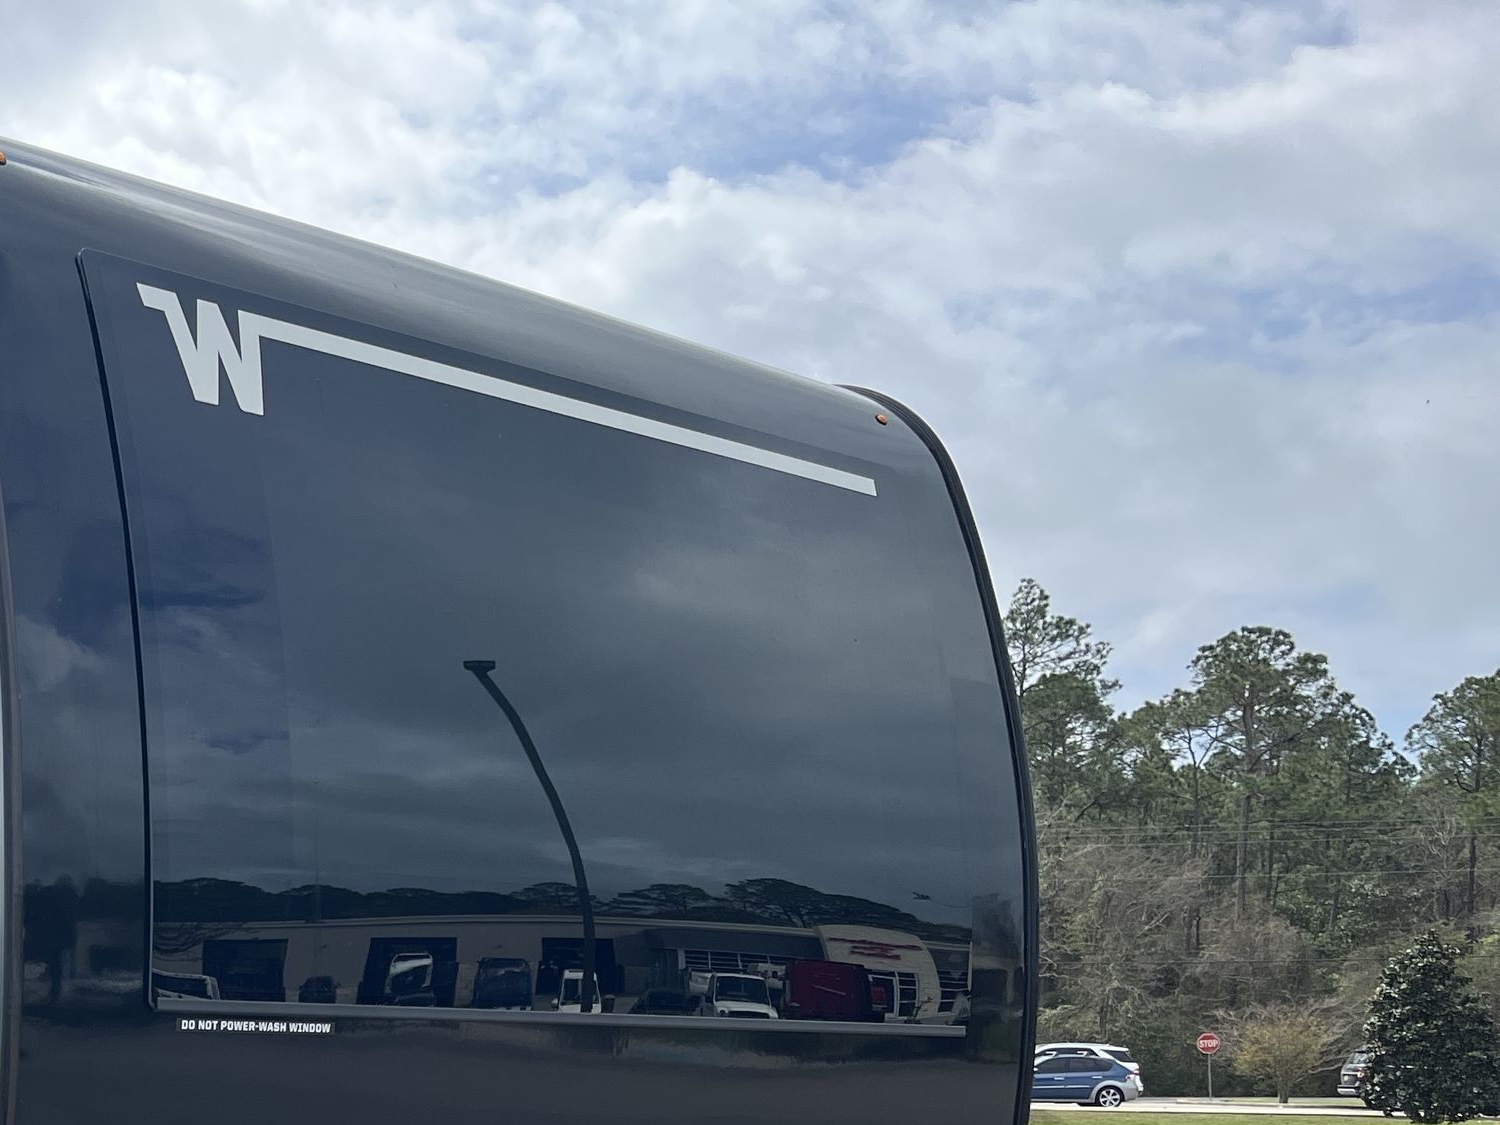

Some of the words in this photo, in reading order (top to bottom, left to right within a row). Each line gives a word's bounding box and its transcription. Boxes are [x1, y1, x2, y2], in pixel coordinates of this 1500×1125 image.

[181, 1019, 196, 1030] DO
[198, 1020, 218, 1031] NOT
[220, 1020, 287, 1032] POWER-WASH
[289, 1022, 331, 1034] WINDOW
[1199, 1039, 1219, 1048] STOP
